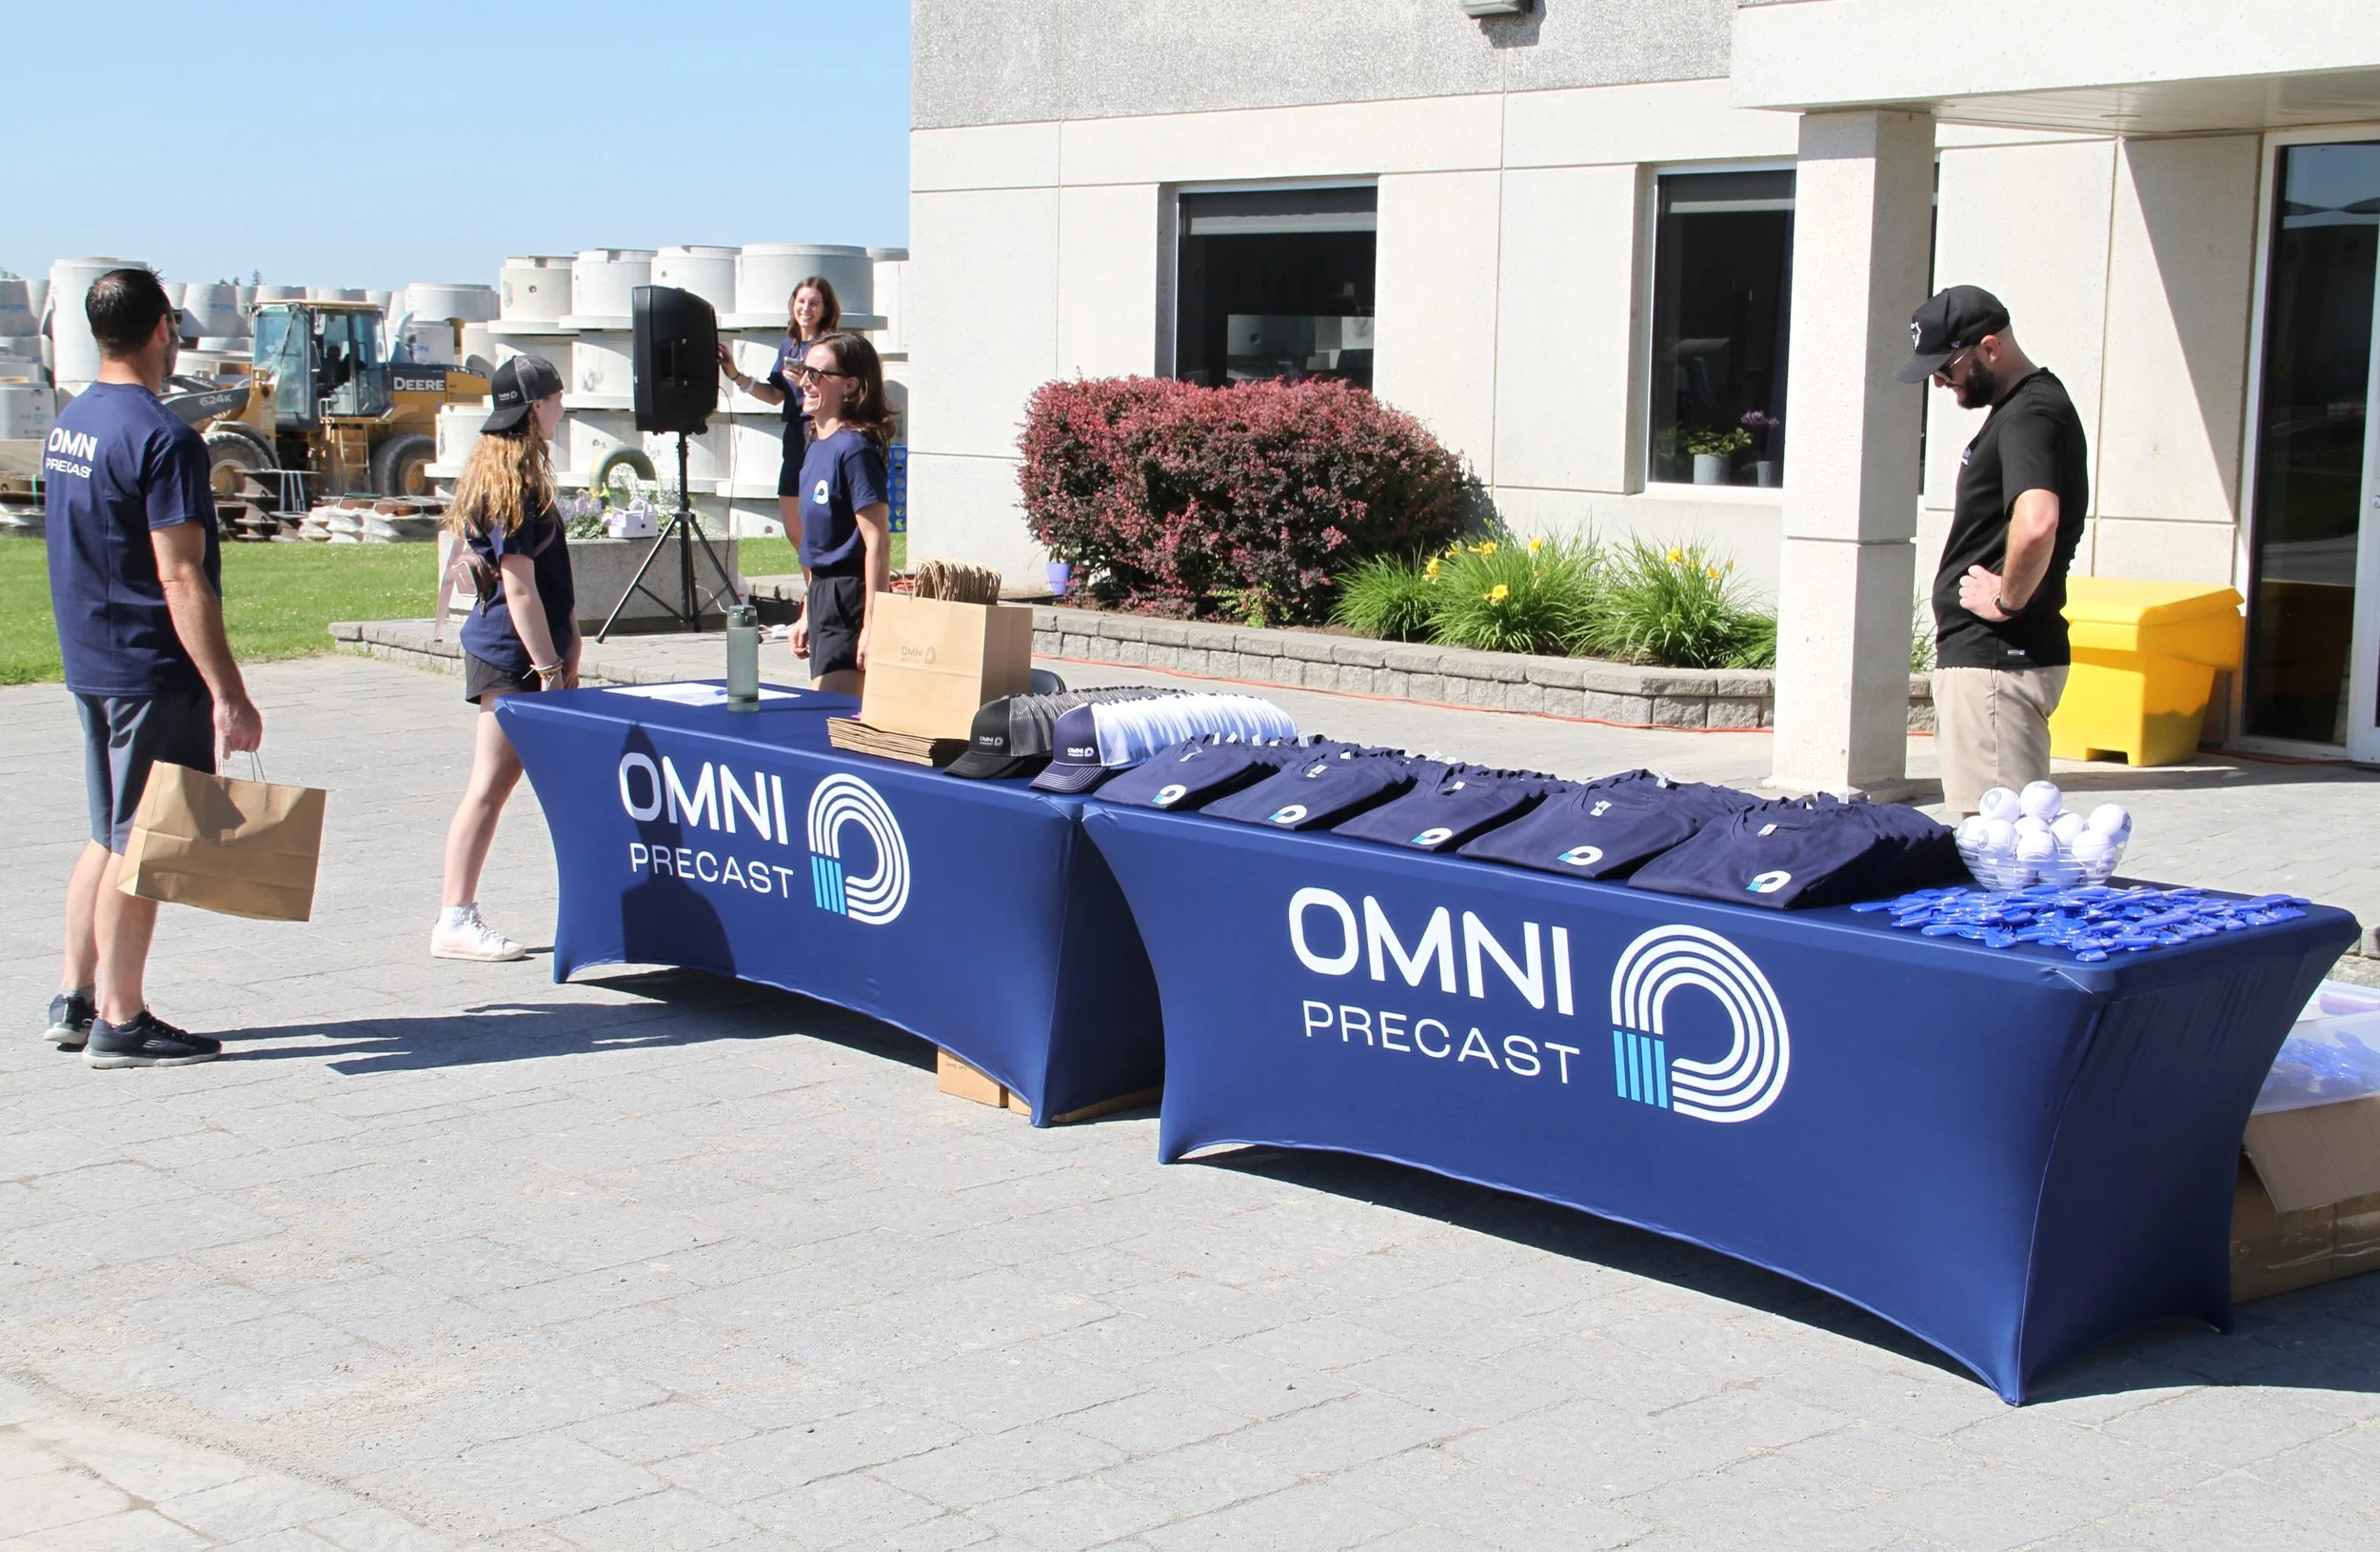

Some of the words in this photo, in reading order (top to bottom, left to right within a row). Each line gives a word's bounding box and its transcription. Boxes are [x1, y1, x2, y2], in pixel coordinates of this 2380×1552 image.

[199, 393, 234, 407] 624K
[393, 376, 446, 391] DEERE
[619, 752, 789, 846] OMNI
[629, 842, 794, 899] PRECAST
[1288, 886, 1575, 1016] OMNI
[1302, 1000, 1580, 1084] PRECAST
